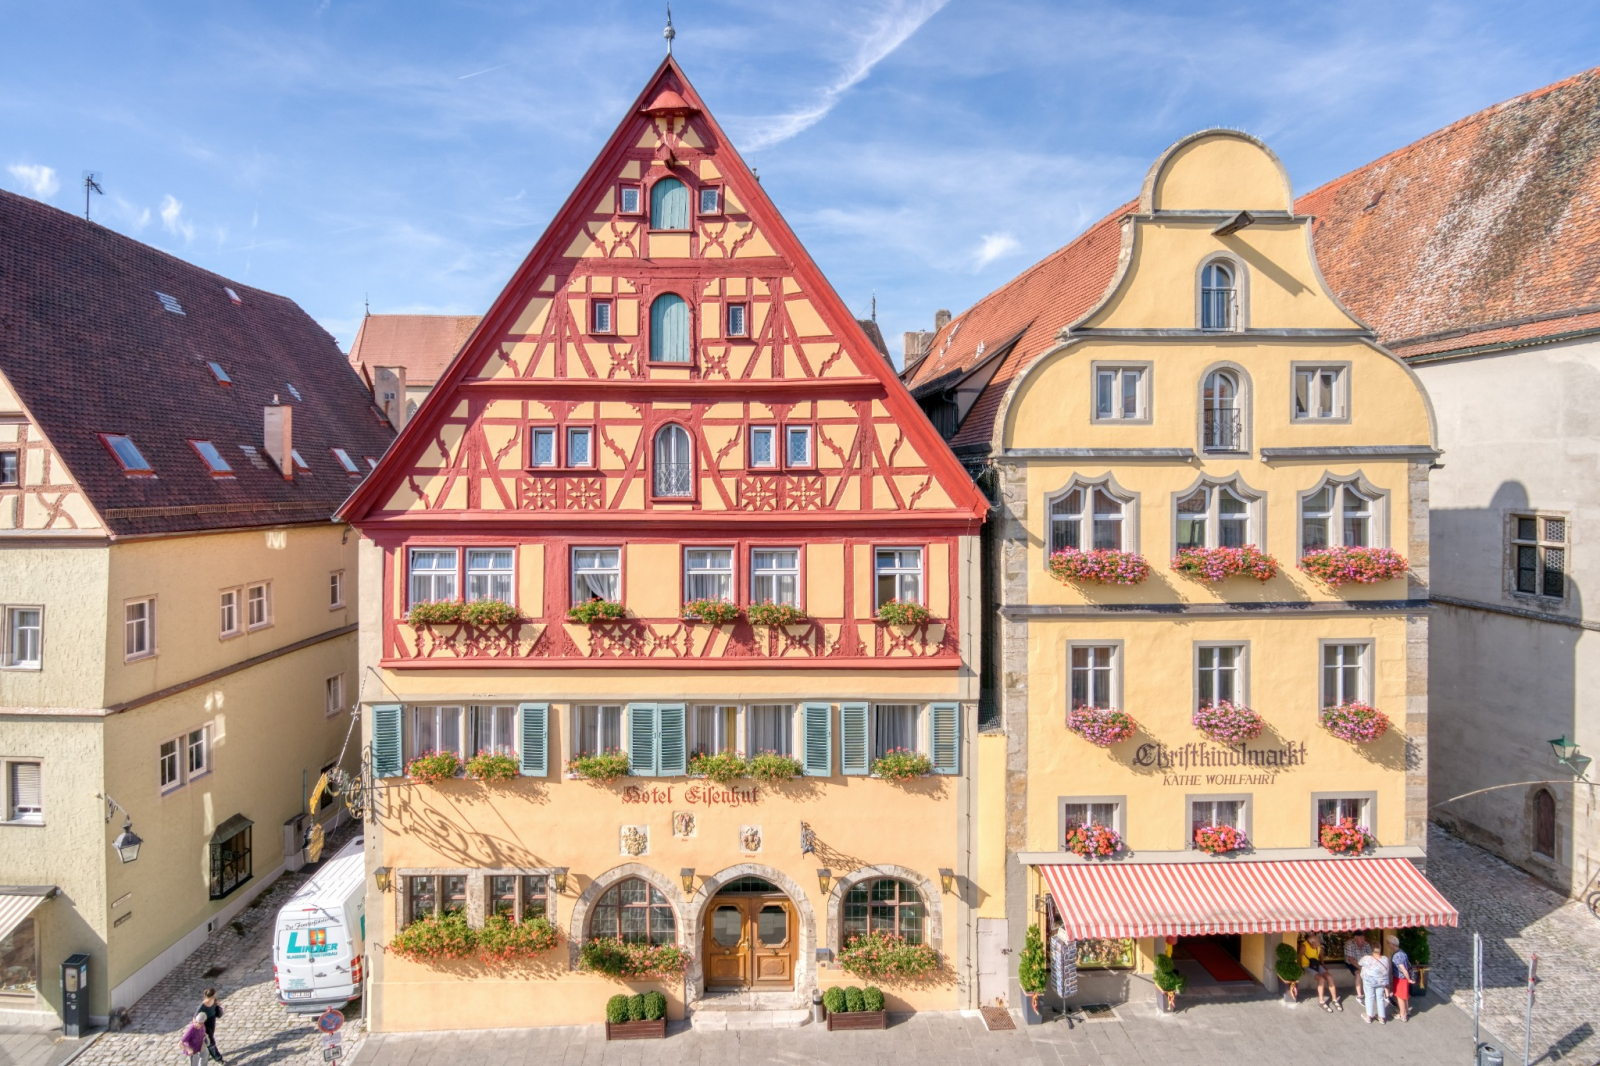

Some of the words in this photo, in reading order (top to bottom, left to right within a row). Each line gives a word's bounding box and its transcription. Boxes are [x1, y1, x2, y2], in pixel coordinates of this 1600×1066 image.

[1206, 774, 1276, 785] WOHLFAHRT
[621, 785, 675, 805] Hotel
[287, 932, 338, 954] LINDNER
